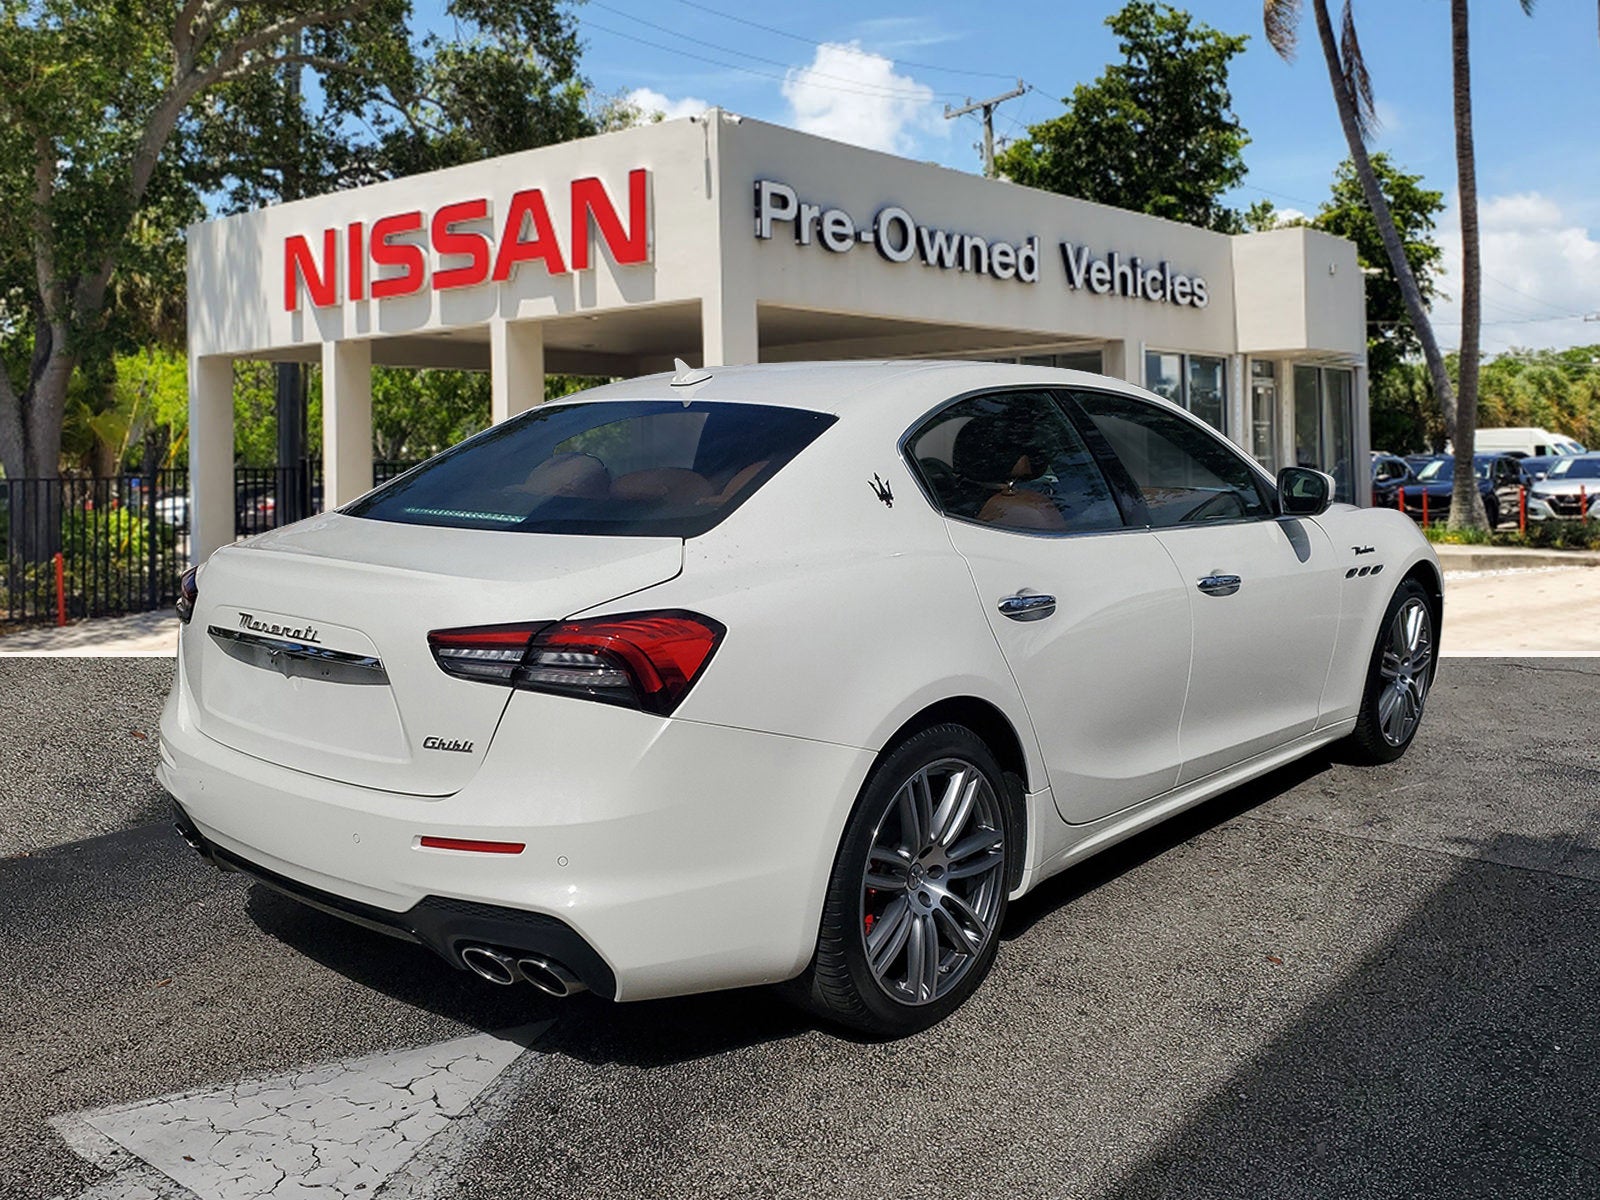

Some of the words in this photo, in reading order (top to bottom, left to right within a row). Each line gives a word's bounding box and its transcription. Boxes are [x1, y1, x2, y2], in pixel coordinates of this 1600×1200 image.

[284, 168, 648, 312] NISSAN
[754, 179, 1040, 283] Pre-Owned
[1061, 240, 1209, 309] Vehicles
[238, 612, 321, 644] Maserati
[423, 736, 474, 753] Ghibli
